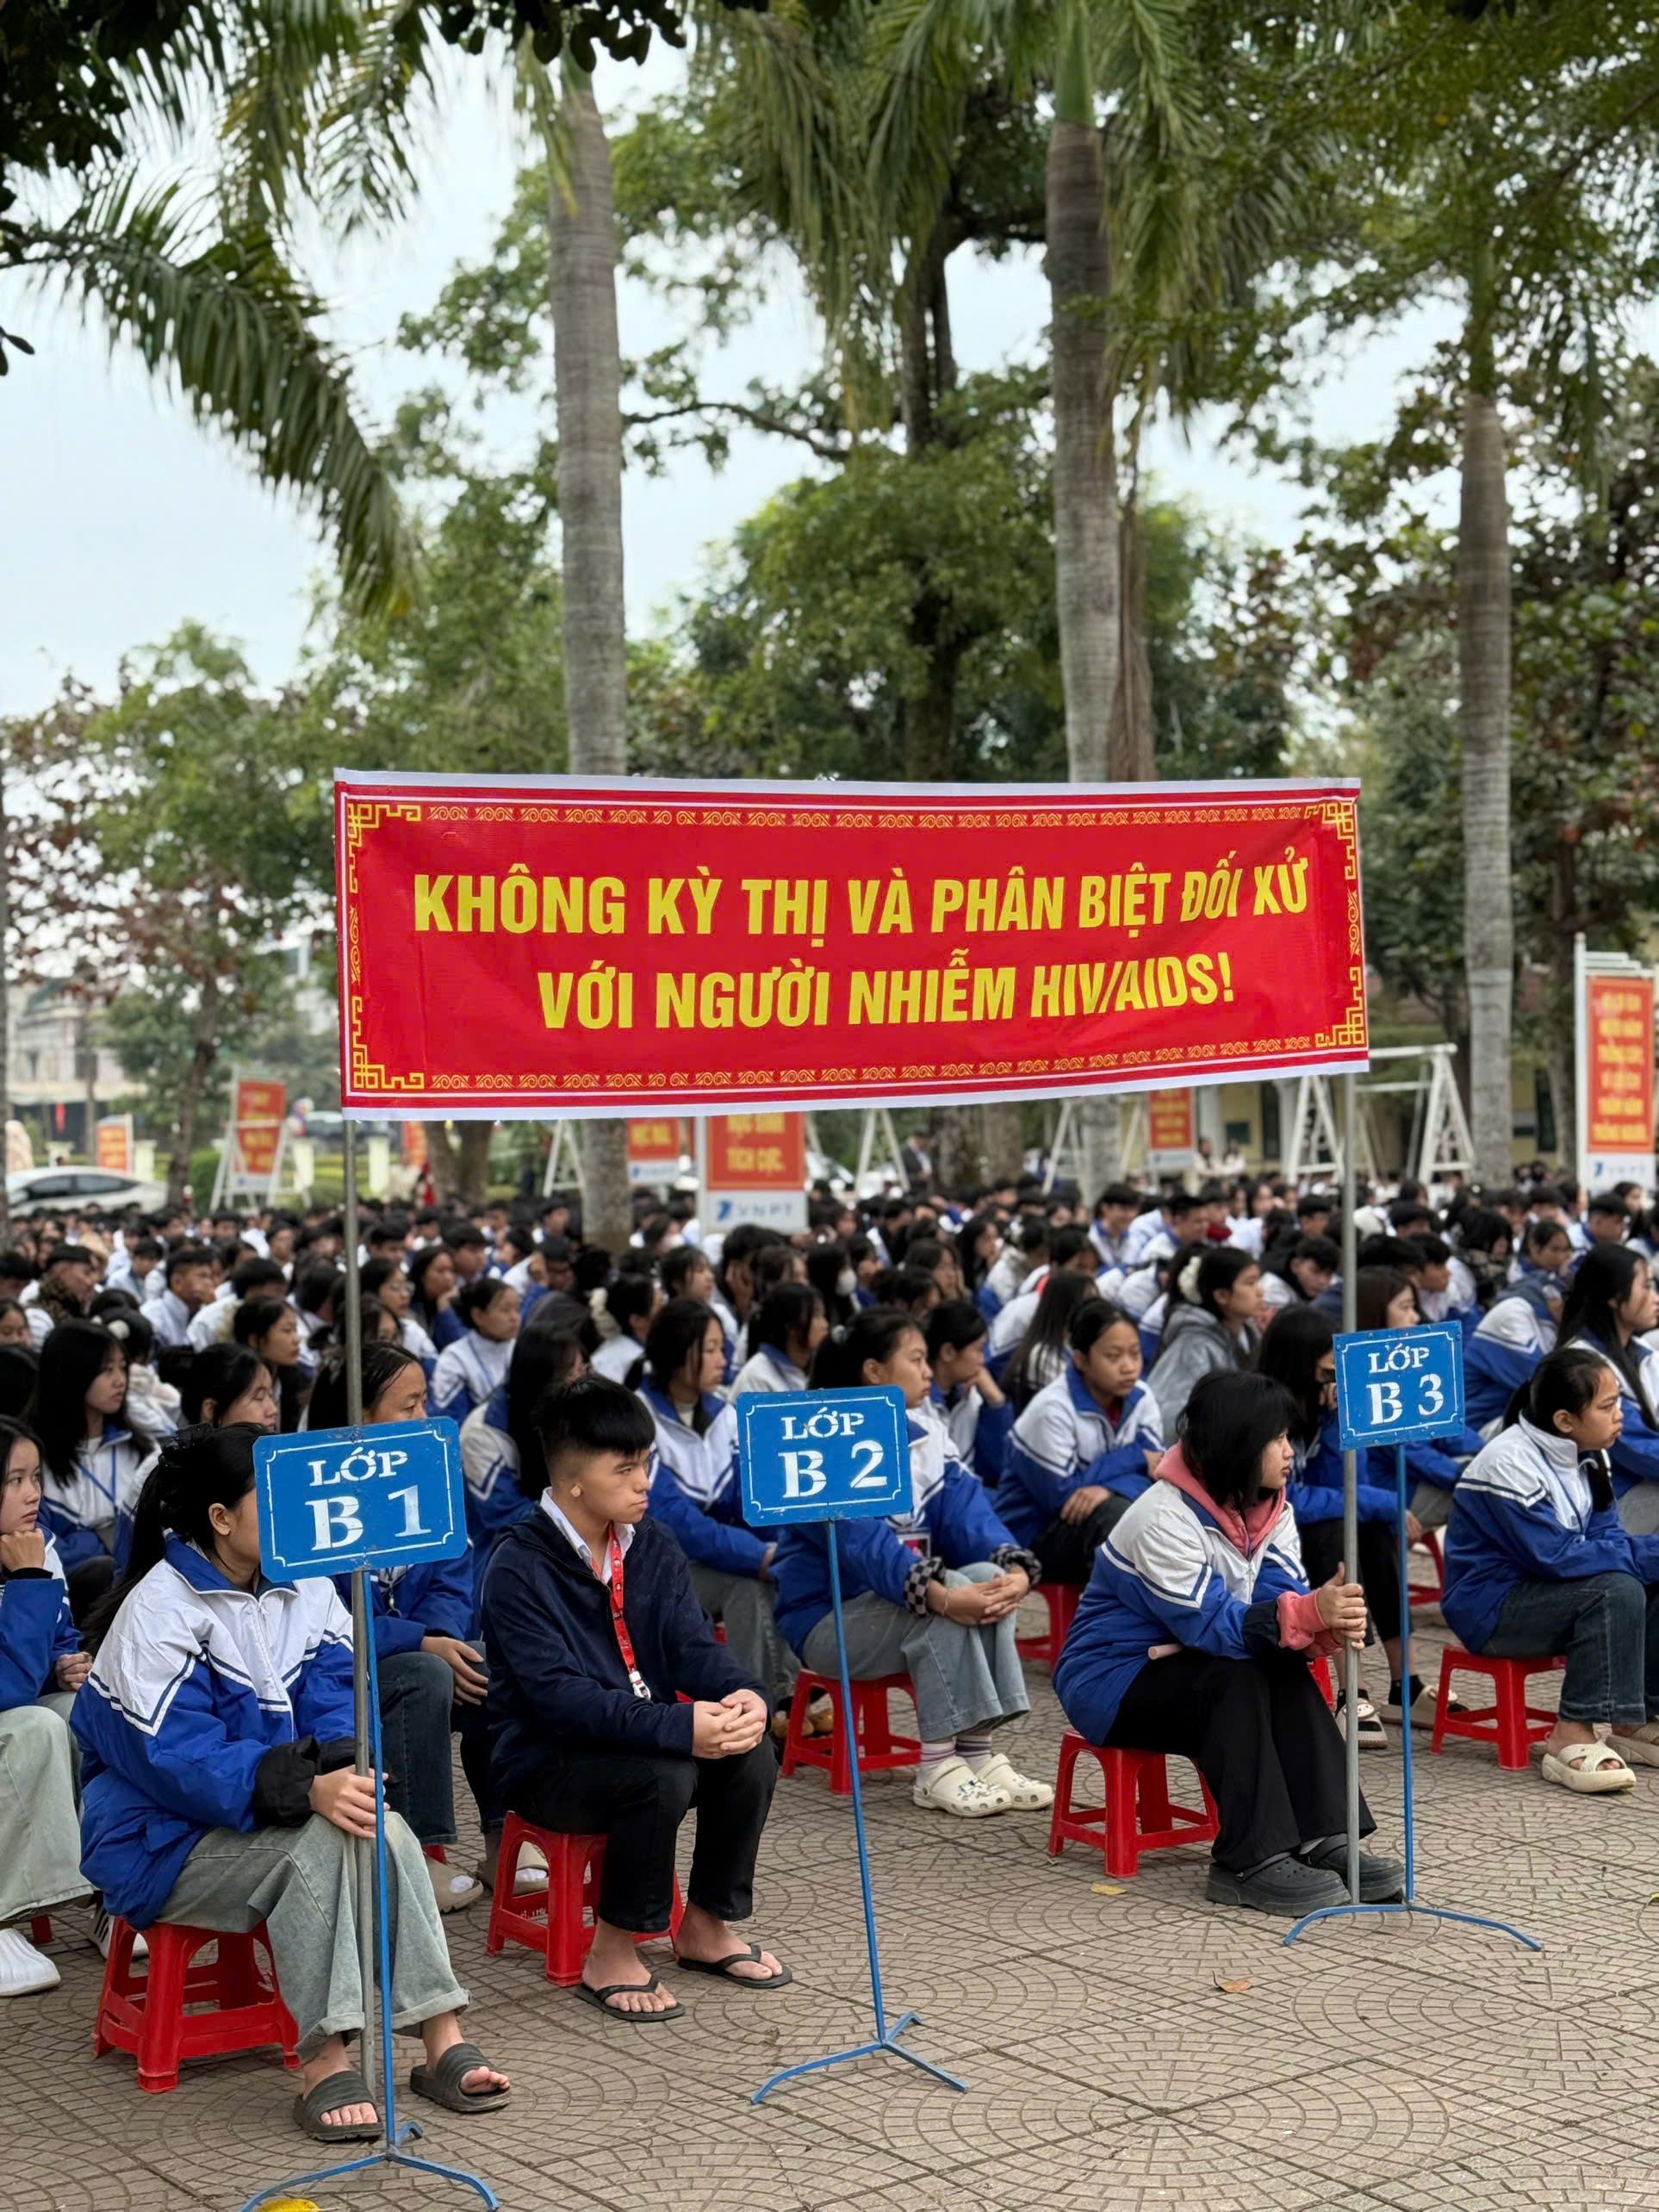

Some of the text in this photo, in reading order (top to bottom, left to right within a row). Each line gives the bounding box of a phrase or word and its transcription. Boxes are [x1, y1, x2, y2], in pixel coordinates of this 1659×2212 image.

[414, 846, 1308, 947] KHÔNG KỲ THỊ VÀ PHÂN BIỆT ĐỐI XỬ
[537, 948, 1234, 1028] VỚI NGƯỜI NHIỄM HIV/AIDS!
[1368, 1342, 1430, 1374] LỚP
[780, 1407, 865, 1440] LỚP
[1365, 1373, 1445, 1426] B 3
[308, 1446, 408, 1487] LỚP
[778, 1439, 888, 1498] B 2
[305, 1484, 432, 1551] B 1
